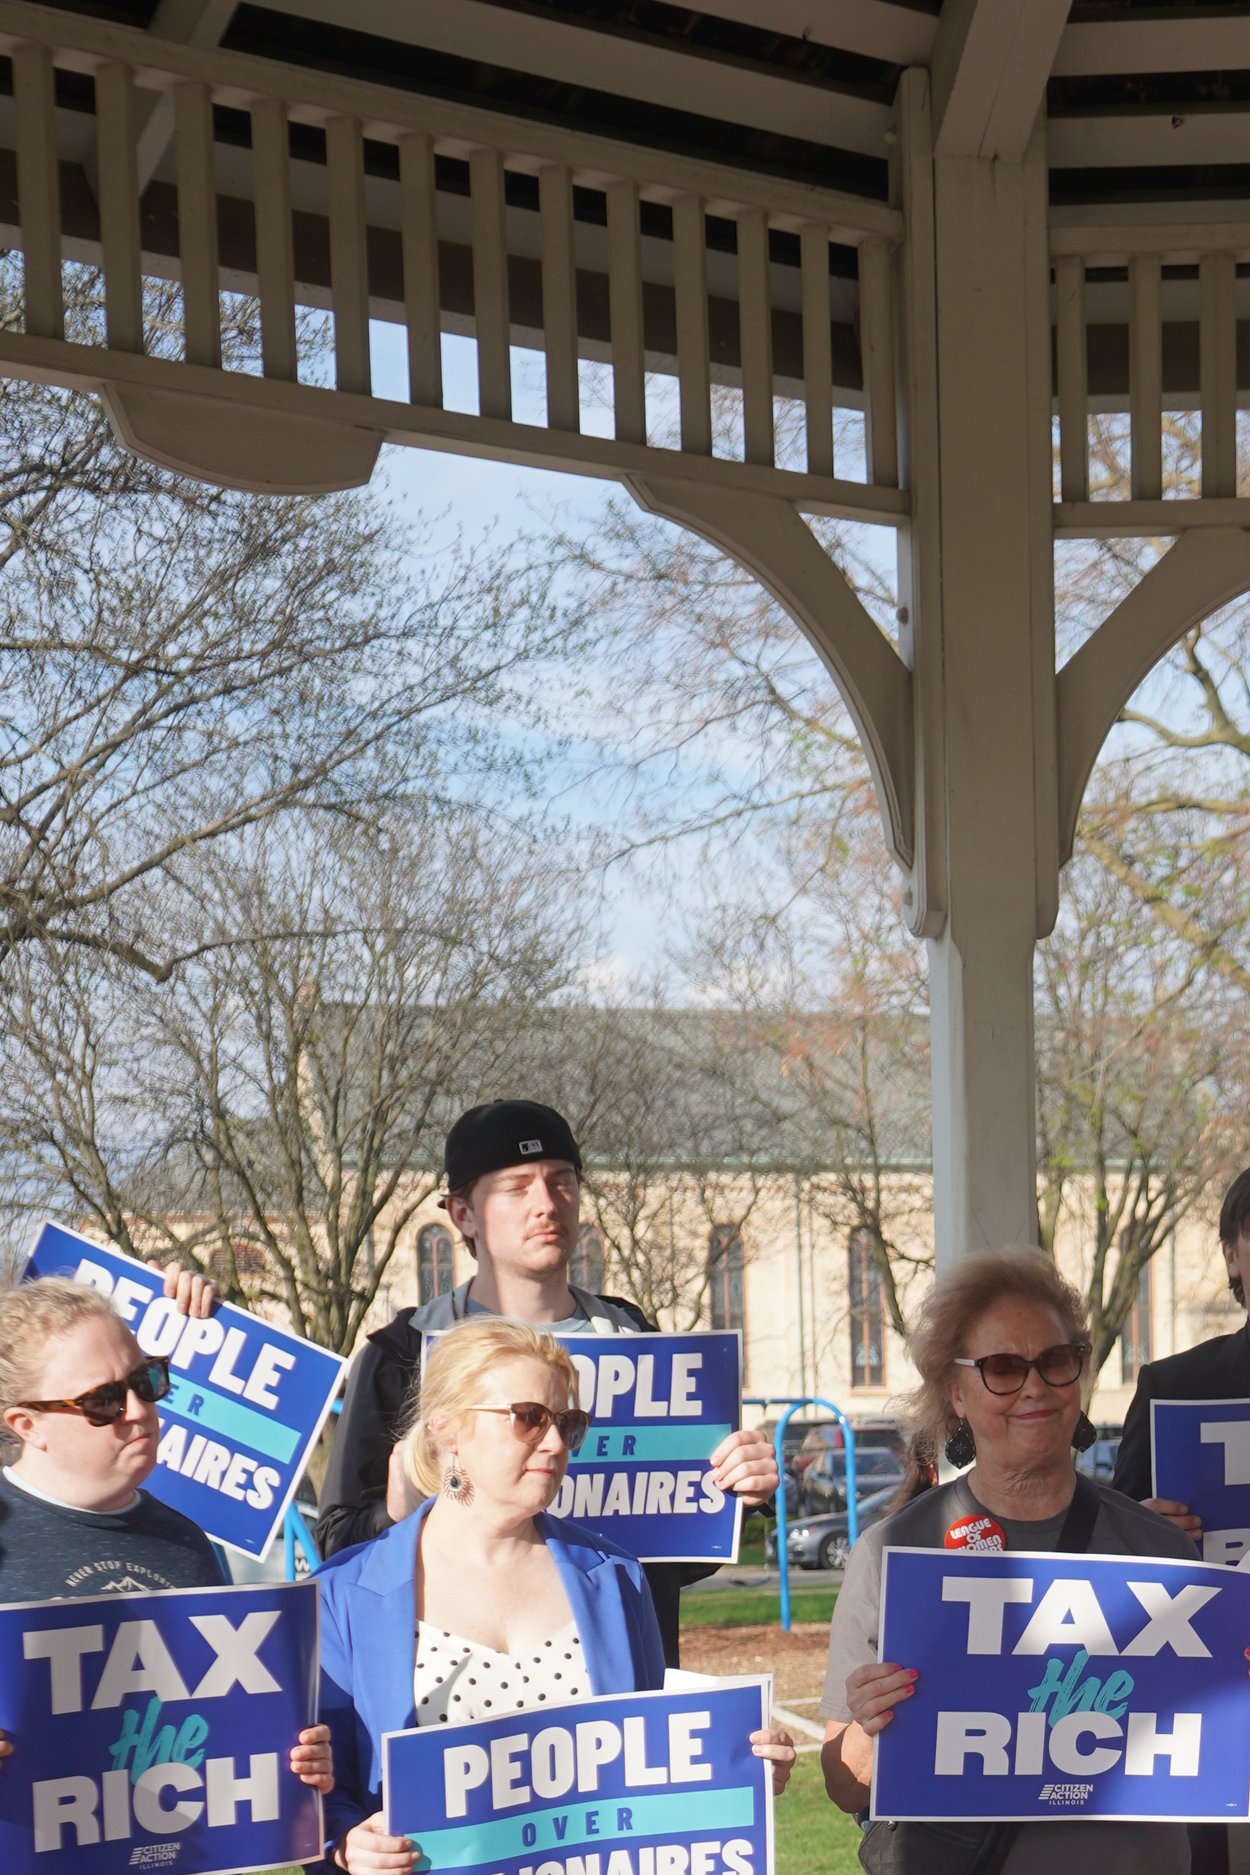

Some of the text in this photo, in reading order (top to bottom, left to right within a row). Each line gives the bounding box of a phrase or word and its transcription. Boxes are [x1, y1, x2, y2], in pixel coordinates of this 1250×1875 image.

[567, 1353, 703, 1418] OPLE
[545, 1470, 725, 1519] ONAIRES
[949, 1518, 992, 1539] LEAGUE
[966, 1531, 982, 1543] OF
[65, 1566, 94, 1588] NEVER
[93, 1560, 121, 1573] STOP
[941, 1575, 1223, 1658] TAX
[23, 1610, 283, 1715] TAX
[1027, 1649, 1134, 1729] the
[109, 1696, 209, 1786] the
[443, 1710, 712, 1819] PEOPLE
[934, 1711, 1202, 1777] RICH
[32, 1752, 280, 1853] RICH
[1050, 1791, 1088, 1800] ACTION
[1054, 1784, 1094, 1793] CITIZEN
[143, 1842, 180, 1854] CITIZEN
[521, 1807, 634, 1847] OVER
[140, 1851, 176, 1863] ACTION
